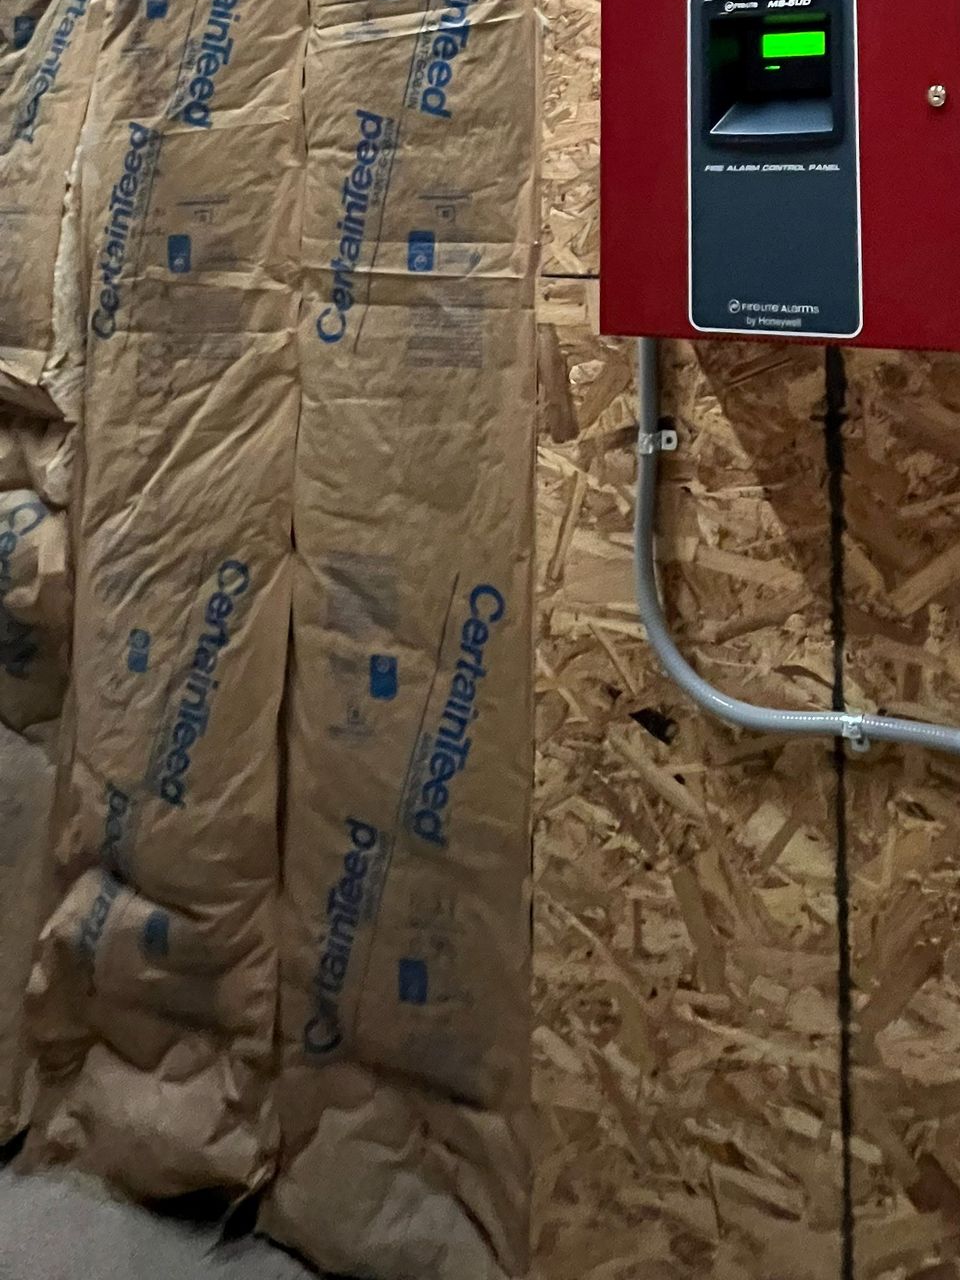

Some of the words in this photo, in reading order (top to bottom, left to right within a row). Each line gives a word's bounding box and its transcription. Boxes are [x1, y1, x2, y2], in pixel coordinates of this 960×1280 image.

[92, 122, 151, 339] CertainTeed
[315, 109, 383, 344] CertainTeed
[704, 164, 725, 173] FIRE
[726, 164, 761, 172] ALARM
[761, 164, 807, 172] CONTROL
[746, 317, 756, 327] by
[413, 584, 506, 848] CertainTeed
